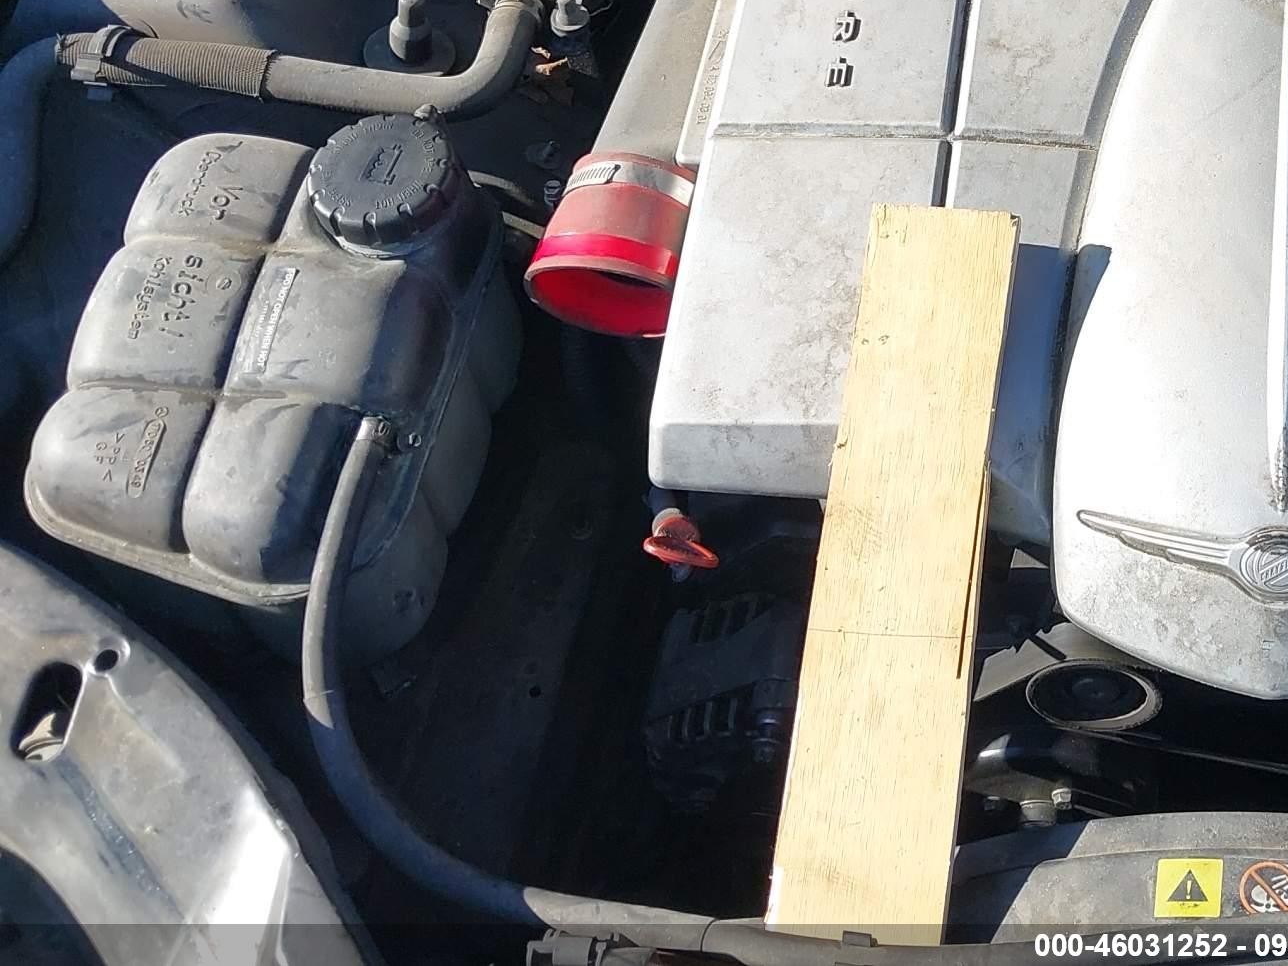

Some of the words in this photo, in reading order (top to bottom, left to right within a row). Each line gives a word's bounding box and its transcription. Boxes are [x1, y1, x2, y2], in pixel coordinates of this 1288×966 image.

[209, 184, 244, 221] Vor
[270, 301, 284, 326] OPEN
[262, 325, 276, 350] WHEN
[256, 349, 268, 367] HOT
